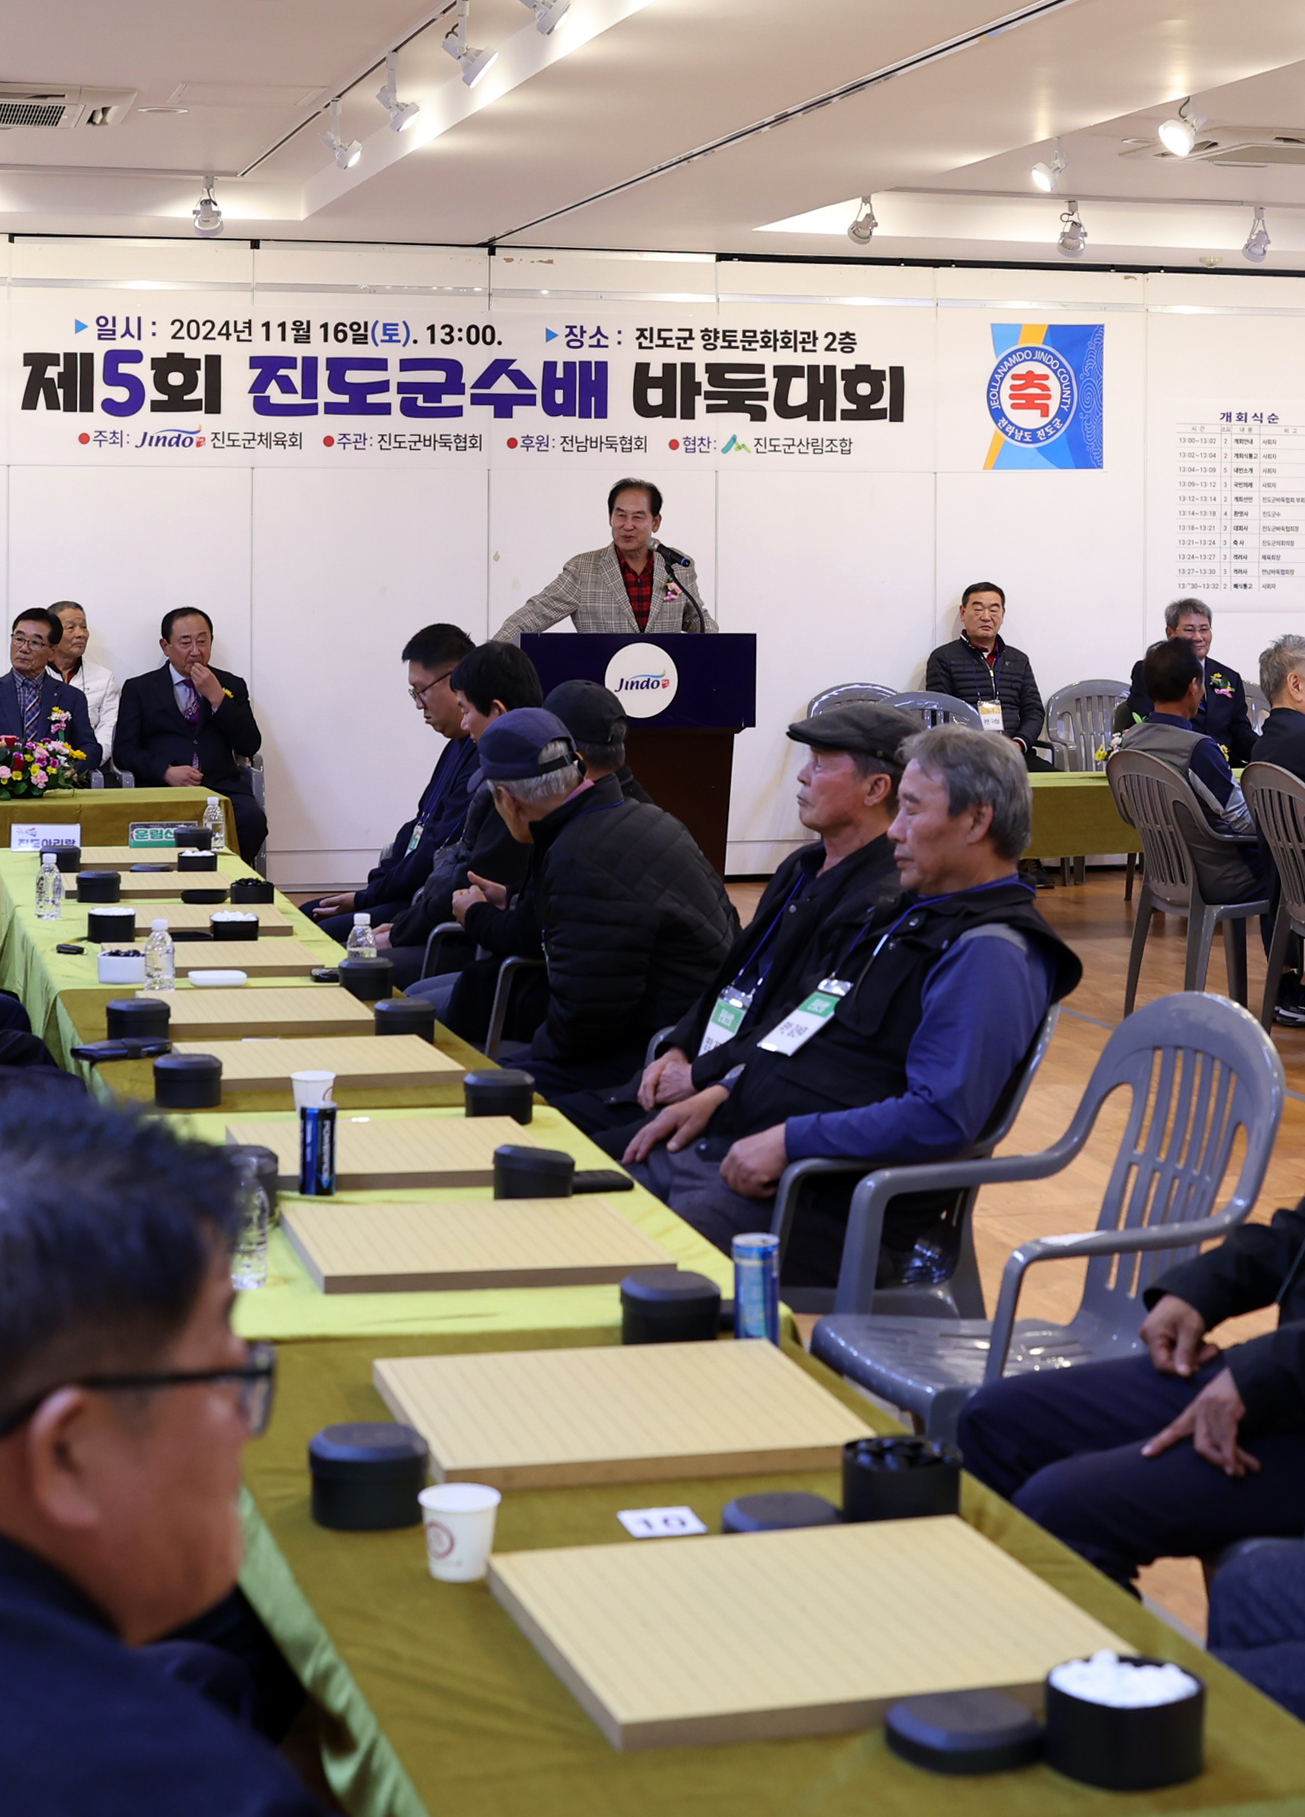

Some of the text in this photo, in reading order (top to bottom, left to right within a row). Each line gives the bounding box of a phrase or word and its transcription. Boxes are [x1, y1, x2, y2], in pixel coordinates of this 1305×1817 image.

[96, 316, 141, 340] 일시
[171, 319, 252, 342] 2024년
[262, 320, 311, 344] 11월
[427, 324, 502, 345] 13:00.
[565, 325, 609, 349] 장소
[636, 327, 695, 350] 진도군
[700, 328, 818, 352] 향토문화회관
[824, 331, 857, 353] 2층
[21, 349, 904, 422] 제5회 진도군수배 바둑대회
[989, 350, 1072, 412] JEOLLANAMDO JINDO COUNTY
[1008, 370, 1052, 418] 축
[93, 430, 303, 450] 주최: Jindo 진도군체육회
[998, 417, 1063, 442] 전라남도 진도군
[337, 432, 483, 453] 주관: 진도군바둑협회
[520, 434, 648, 453] 후원: 전남바둑협회
[682, 435, 853, 455] 협찬: 진도군산림조합
[614, 677, 660, 693] Jindo
[135, 829, 175, 840] 운림산
